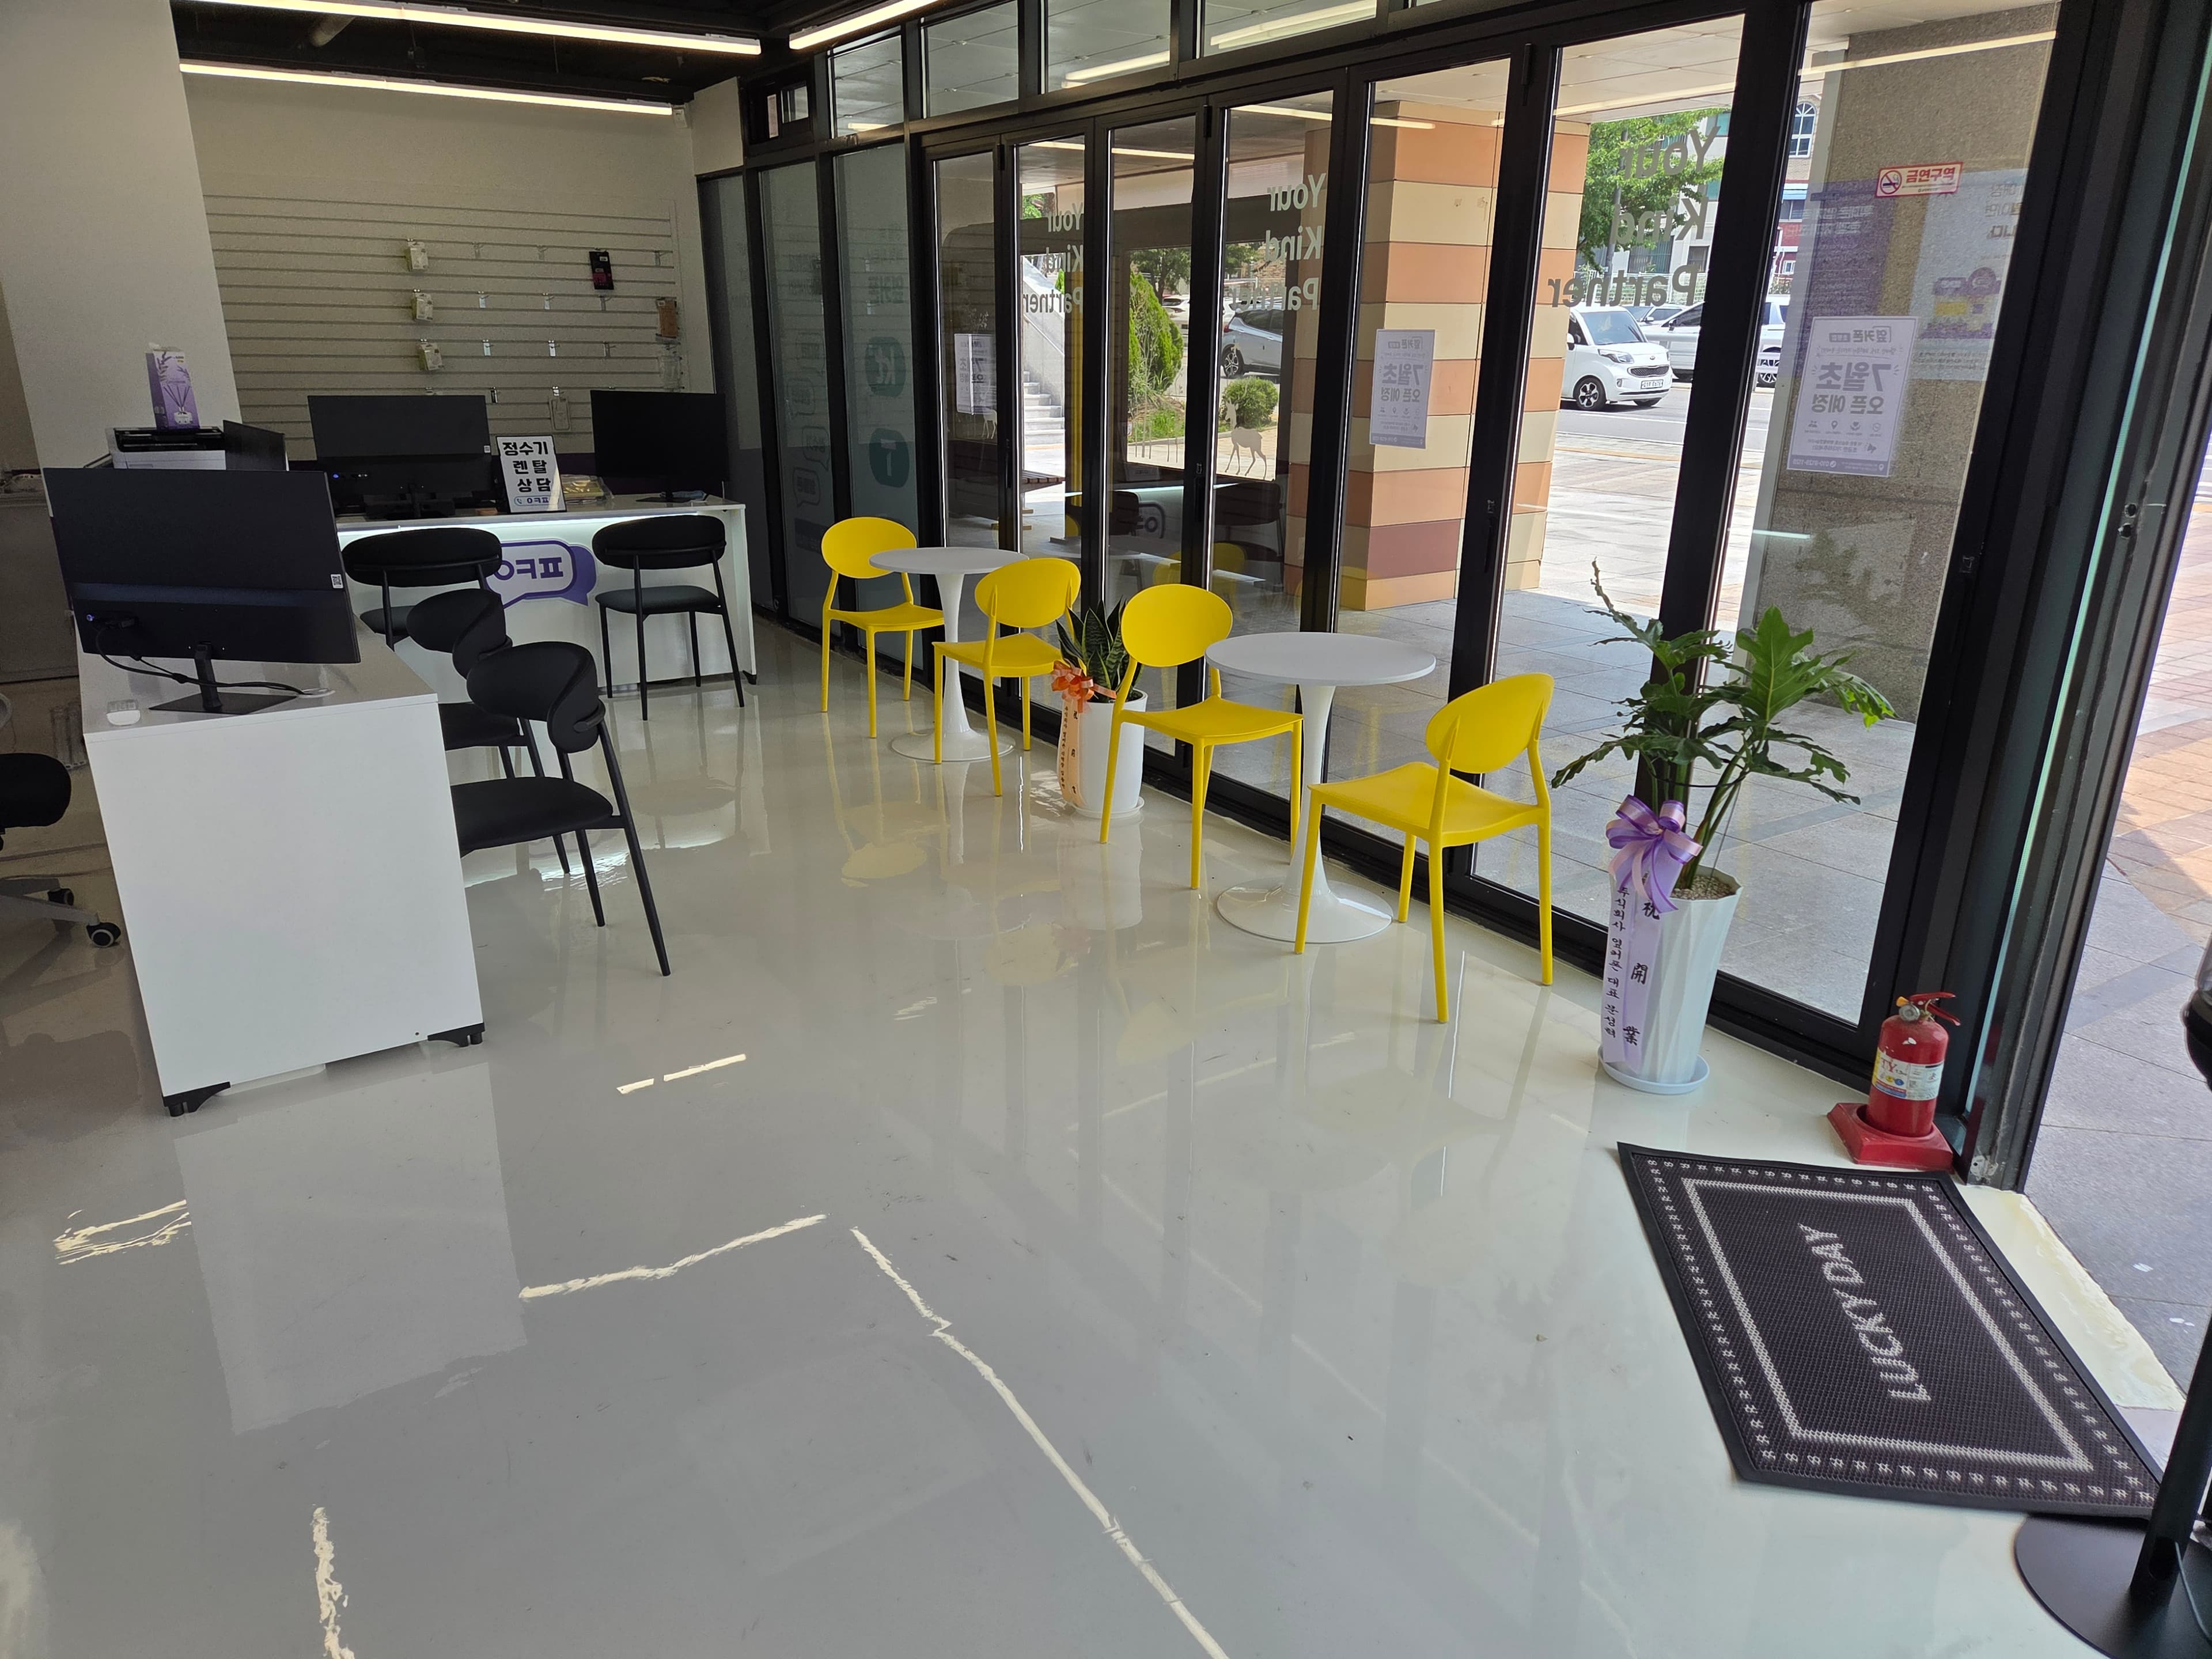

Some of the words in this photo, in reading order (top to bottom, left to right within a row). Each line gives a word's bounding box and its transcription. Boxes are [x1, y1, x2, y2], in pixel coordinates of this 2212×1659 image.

[1906, 167, 1955, 183] 금연구역
[503, 441, 548, 456] 정수기
[513, 460, 547, 474] 렌탈
[517, 478, 551, 492] 상담
[1798, 1222, 1864, 1286] DAY
[1833, 1288, 1931, 1402] LUCKY
